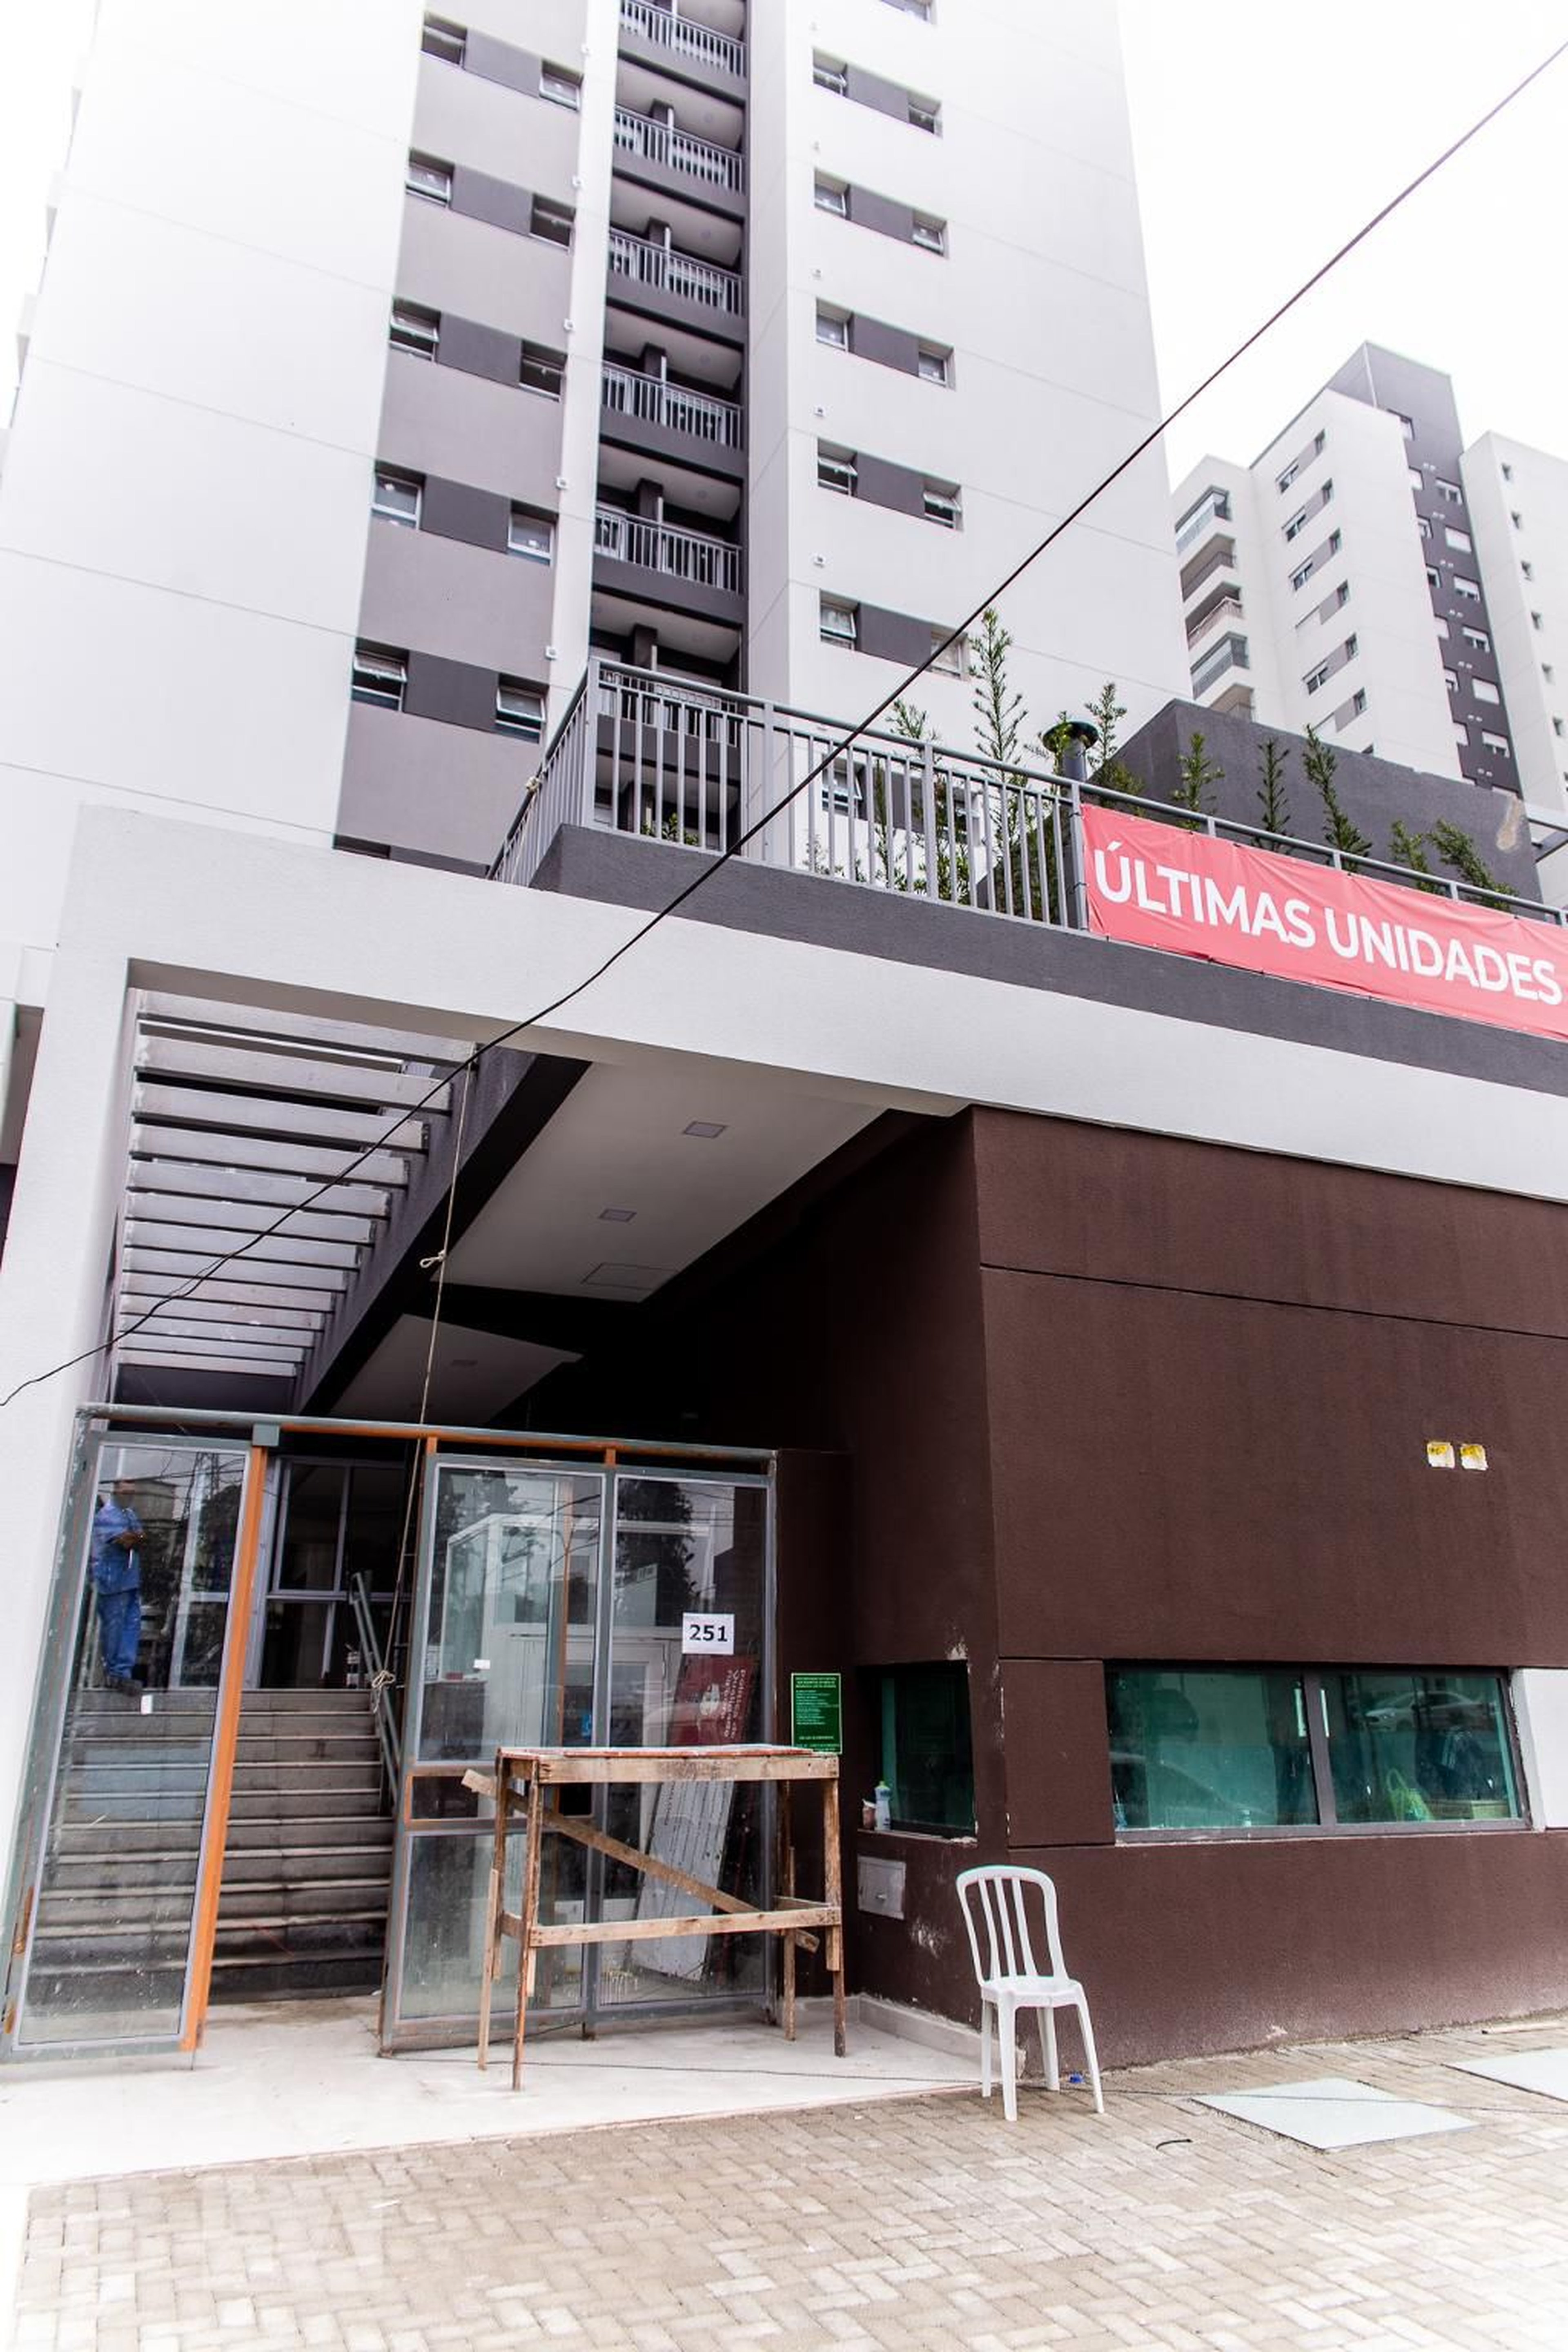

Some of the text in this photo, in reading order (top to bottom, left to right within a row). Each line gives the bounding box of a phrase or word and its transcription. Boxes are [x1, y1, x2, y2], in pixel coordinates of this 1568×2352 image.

[1094, 841, 1563, 1006] ÚLTIMAS UNIDADES
[690, 1624, 728, 1642] 251
